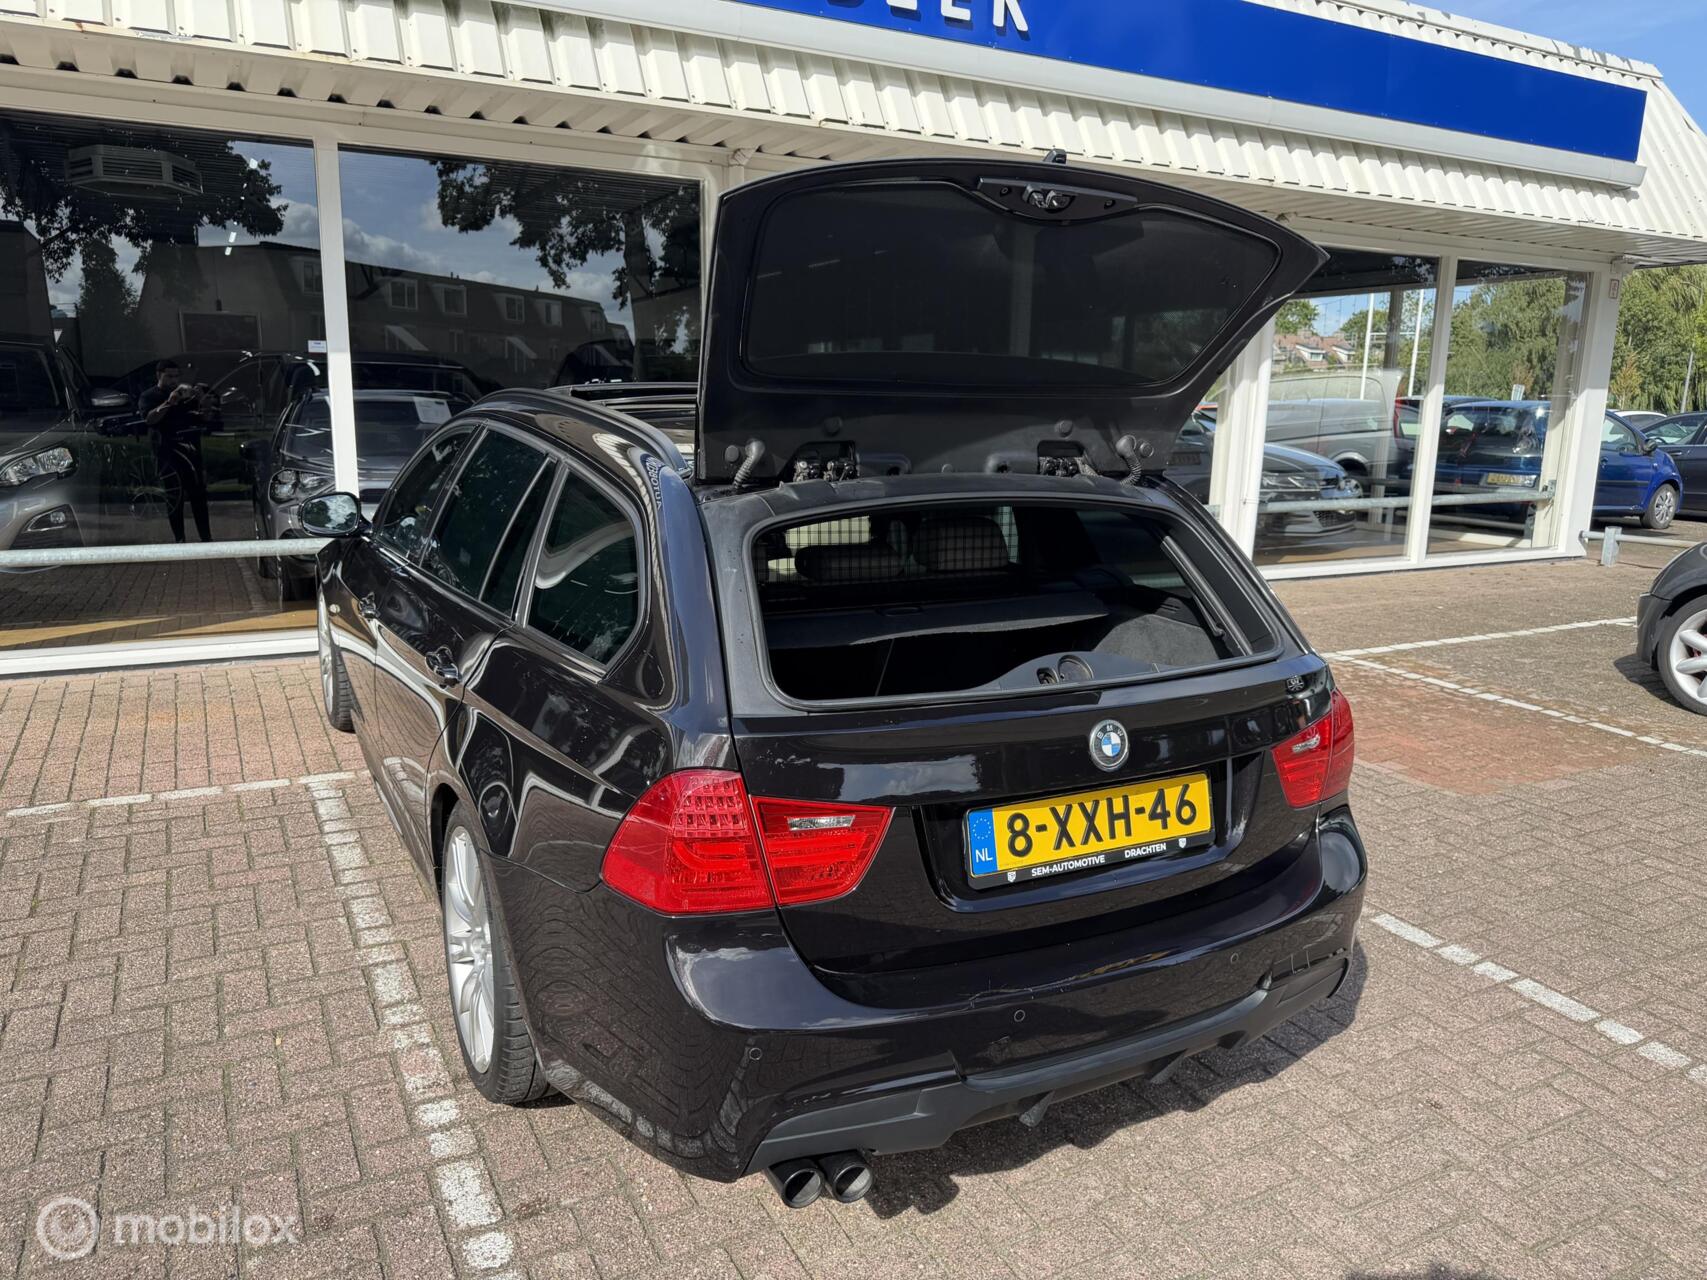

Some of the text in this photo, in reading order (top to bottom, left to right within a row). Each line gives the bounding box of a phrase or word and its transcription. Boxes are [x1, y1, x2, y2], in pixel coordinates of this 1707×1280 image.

[1096, 724, 1124, 739] BMW
[1006, 783, 1197, 857] 8-XXH-46
[975, 848, 993, 863] NL
[1031, 843, 1167, 877] SEM-AUTOMOTIVE DRACHTEN
